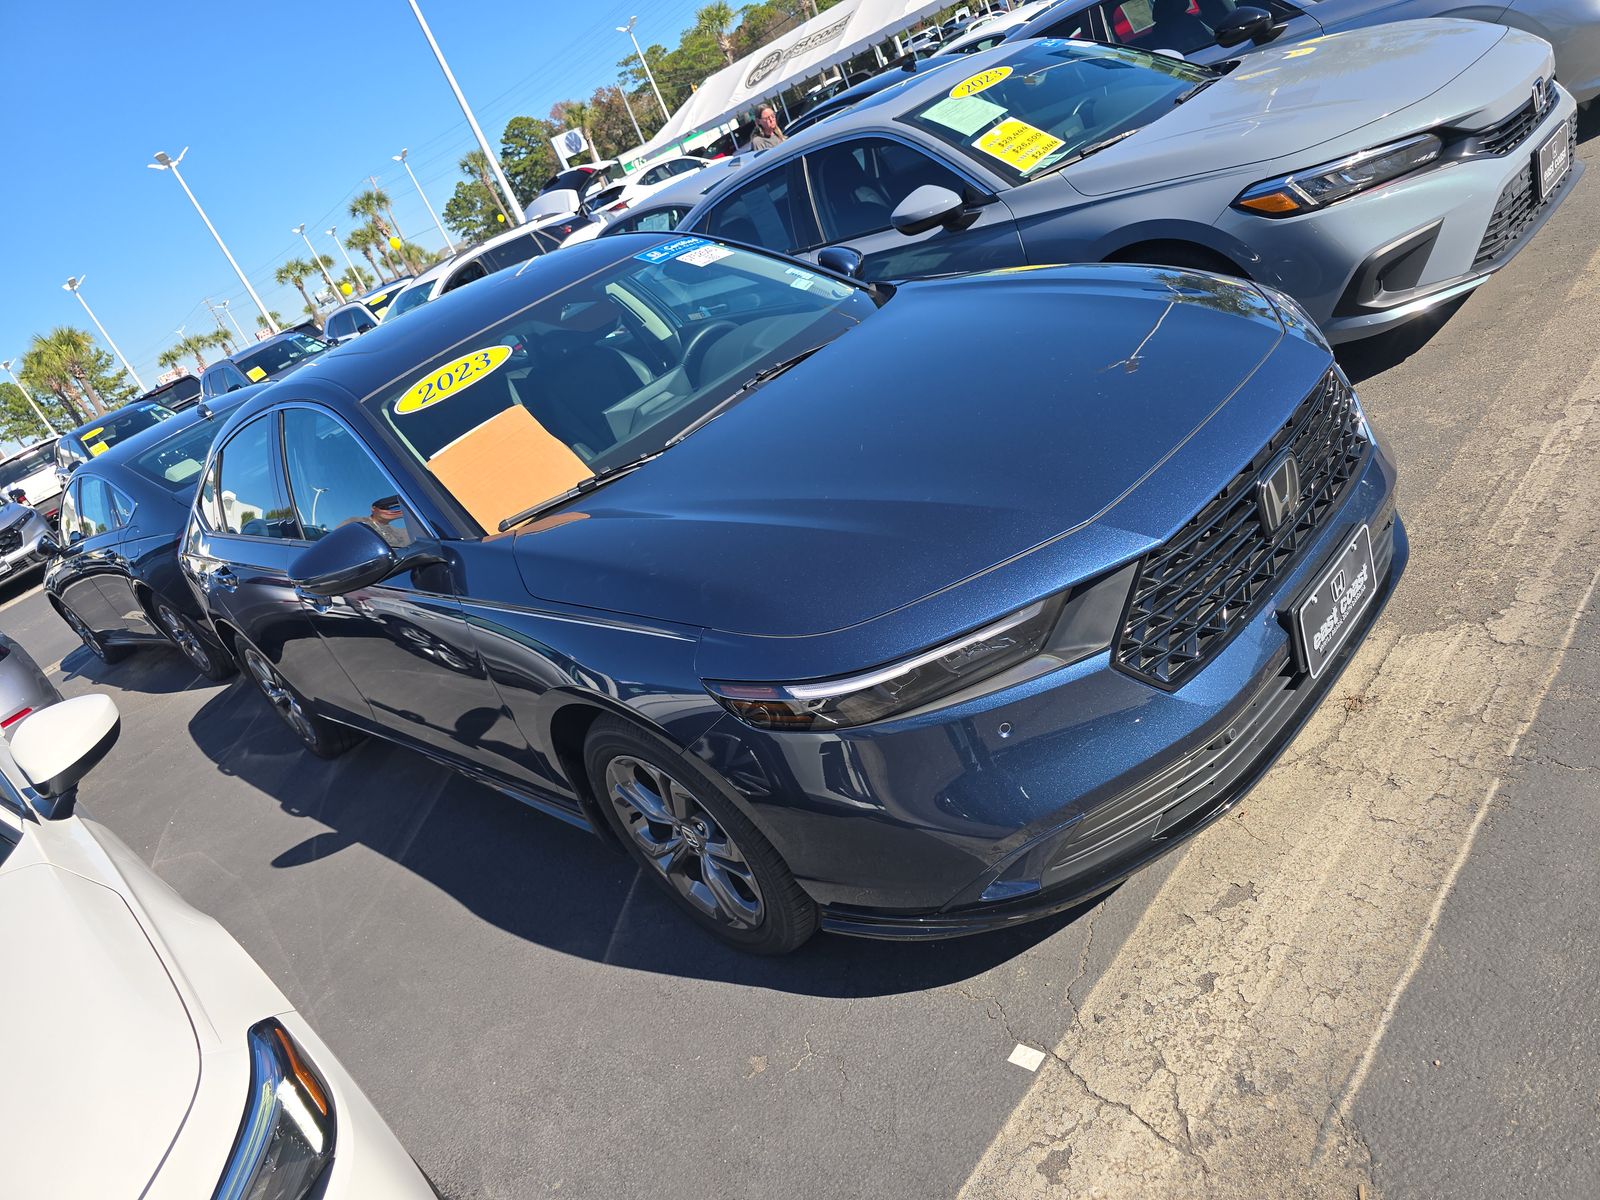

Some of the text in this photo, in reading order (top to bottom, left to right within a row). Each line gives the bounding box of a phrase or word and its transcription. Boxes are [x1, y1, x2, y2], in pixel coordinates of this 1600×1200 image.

[961, 70, 1003, 93] 2023
[417, 352, 491, 405] 2023
[1313, 605, 1339, 651] east
[1340, 563, 1368, 614] coast
